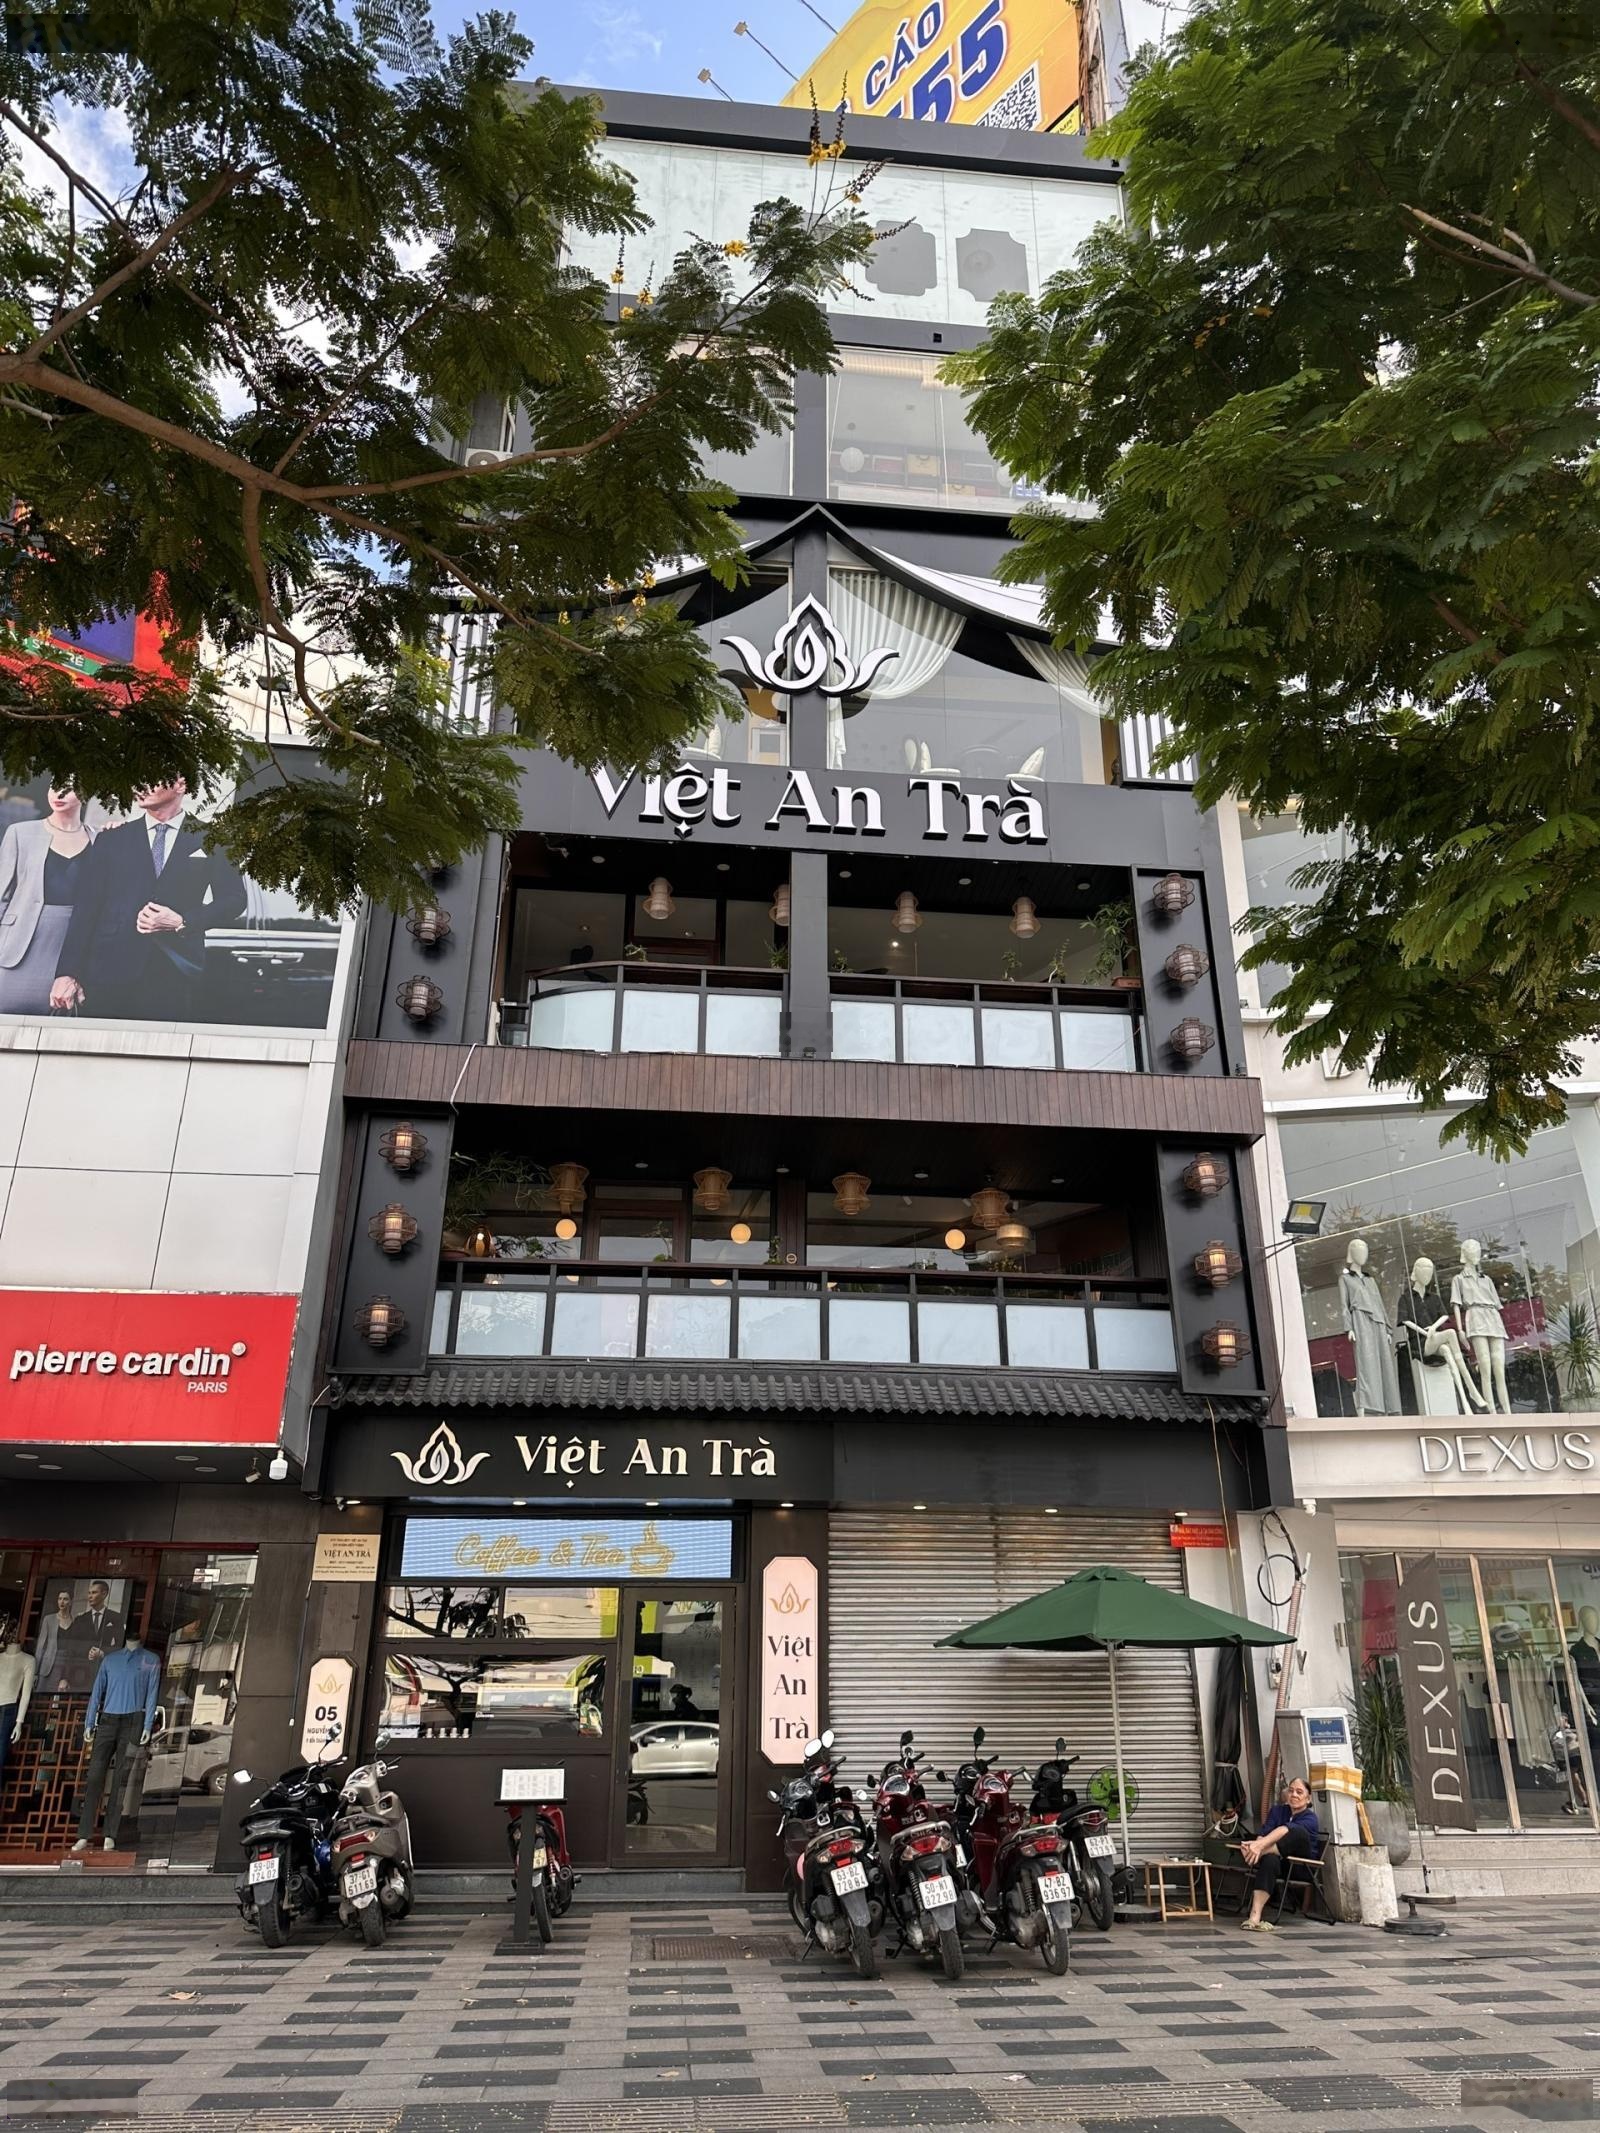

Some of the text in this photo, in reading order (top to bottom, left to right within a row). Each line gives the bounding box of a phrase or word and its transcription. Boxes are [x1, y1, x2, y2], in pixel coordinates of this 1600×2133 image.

[864, 0, 943, 107] CÁO
[589, 762, 1048, 845] Việt An Trà
[9, 1343, 231, 1380] pierre cardin
[187, 1381, 228, 1393] PARIS
[514, 1435, 777, 1489] Việt An Trà
[1418, 1431, 1595, 1473] DEXUS
[455, 1534, 626, 1573] Coffee & Tea
[767, 1634, 814, 1663] Việt
[773, 1673, 807, 1695] An
[1407, 1600, 1464, 1803] DEXUS
[315, 1705, 338, 1721] 05
[769, 1716, 809, 1739] Trà
